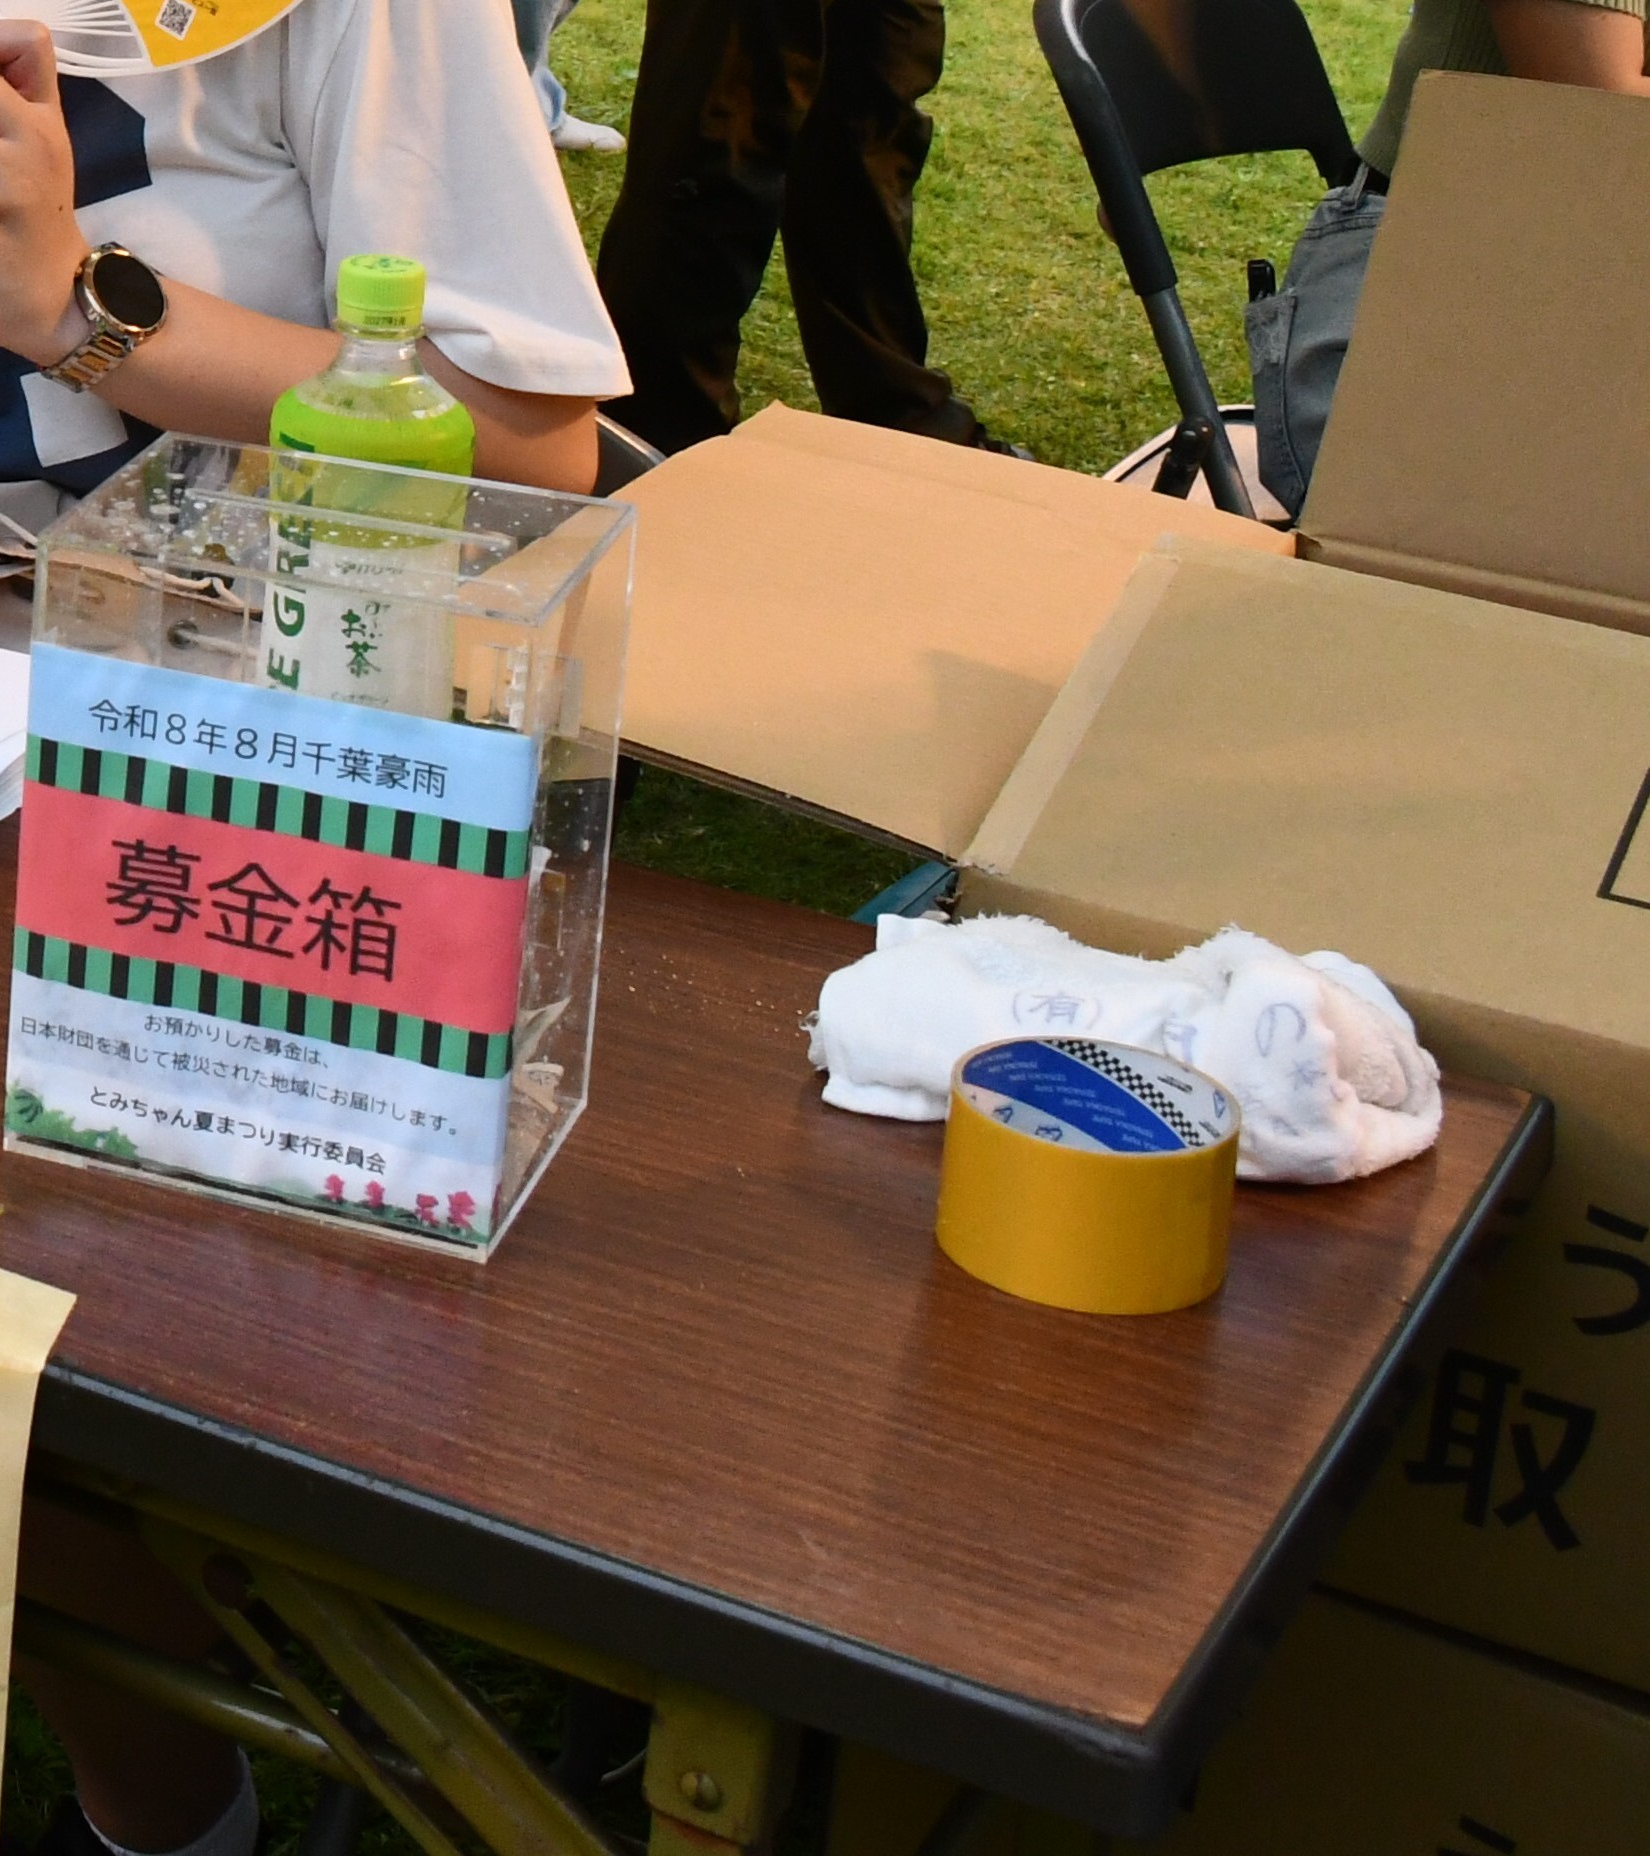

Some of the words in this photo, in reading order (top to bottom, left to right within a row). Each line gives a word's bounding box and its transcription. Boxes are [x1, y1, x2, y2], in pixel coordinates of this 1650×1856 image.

[105, 838, 403, 983] 募金箱
[143, 1013, 330, 1070] お預かりした募金は、
[90, 1085, 387, 1176] とみちゃん夏まつり実行委員会
